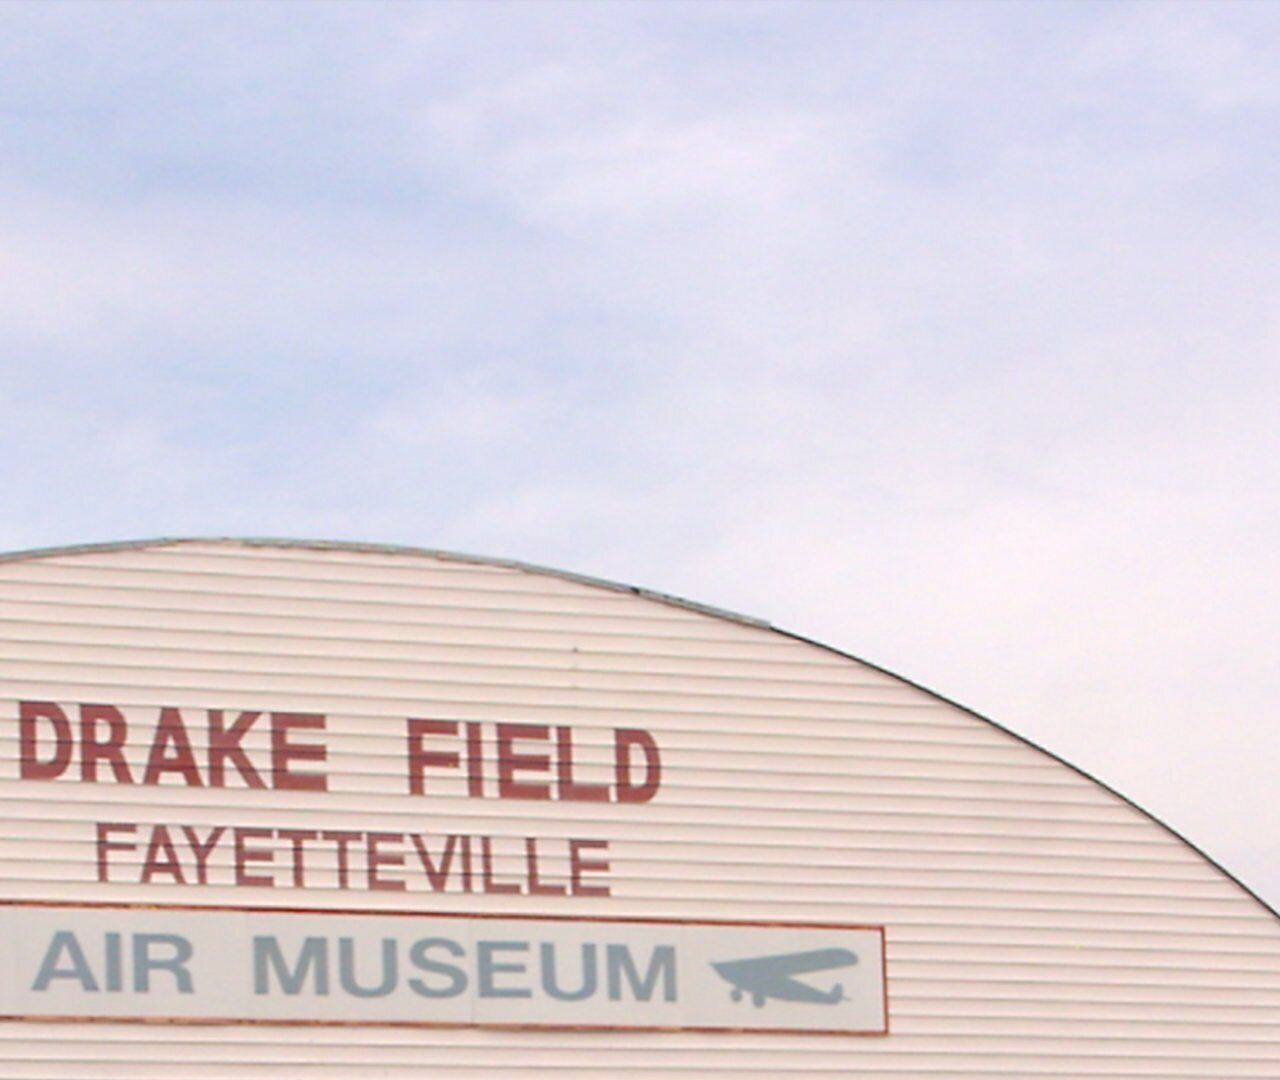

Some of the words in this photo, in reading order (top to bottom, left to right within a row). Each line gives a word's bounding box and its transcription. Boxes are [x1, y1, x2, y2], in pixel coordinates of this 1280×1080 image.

[19, 699, 328, 793] DRAKE
[407, 717, 662, 804] FIELD
[95, 821, 611, 897] FAYETTEVILLE
[30, 930, 195, 994] AIR
[251, 934, 679, 1004] MUSEUM
